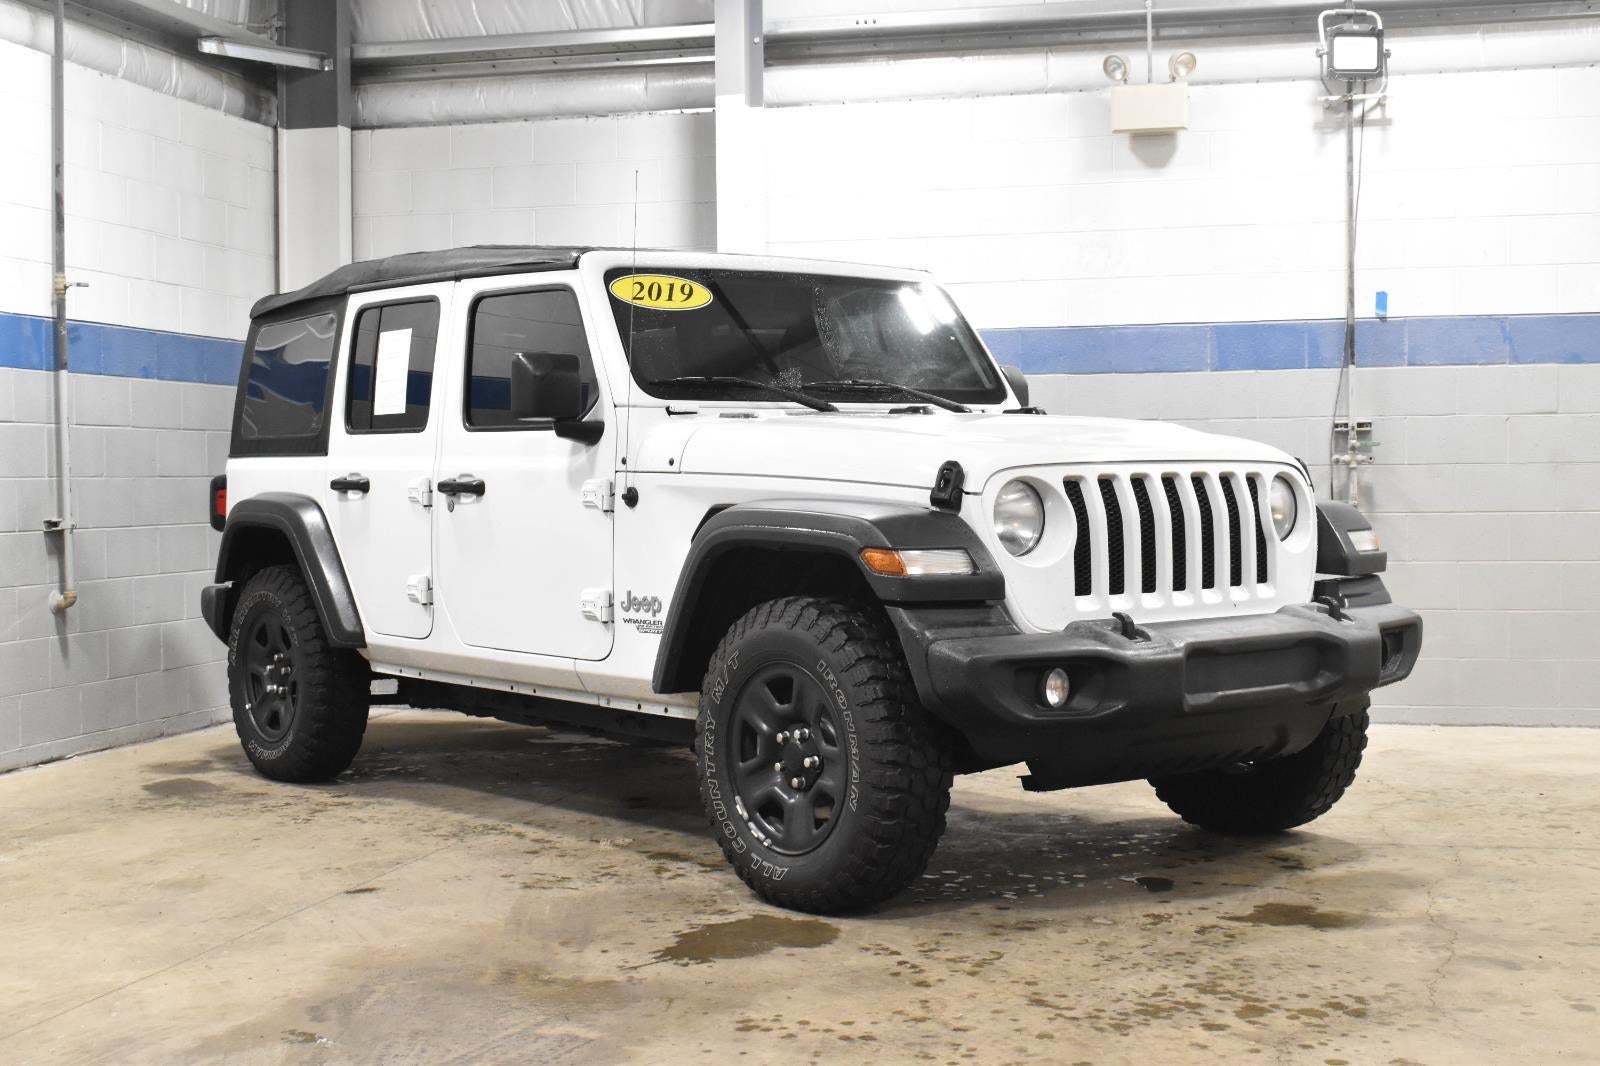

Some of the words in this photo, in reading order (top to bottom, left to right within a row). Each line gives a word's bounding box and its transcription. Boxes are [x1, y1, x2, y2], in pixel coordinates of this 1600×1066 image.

[631, 281, 694, 303] 2019
[620, 589, 662, 617] Jeep
[622, 617, 662, 625] WRANGLER
[711, 649, 740, 704] M/T
[816, 659, 861, 813] IRONMAN
[704, 709, 747, 854] COUNTRY
[750, 852, 789, 881] ALL
